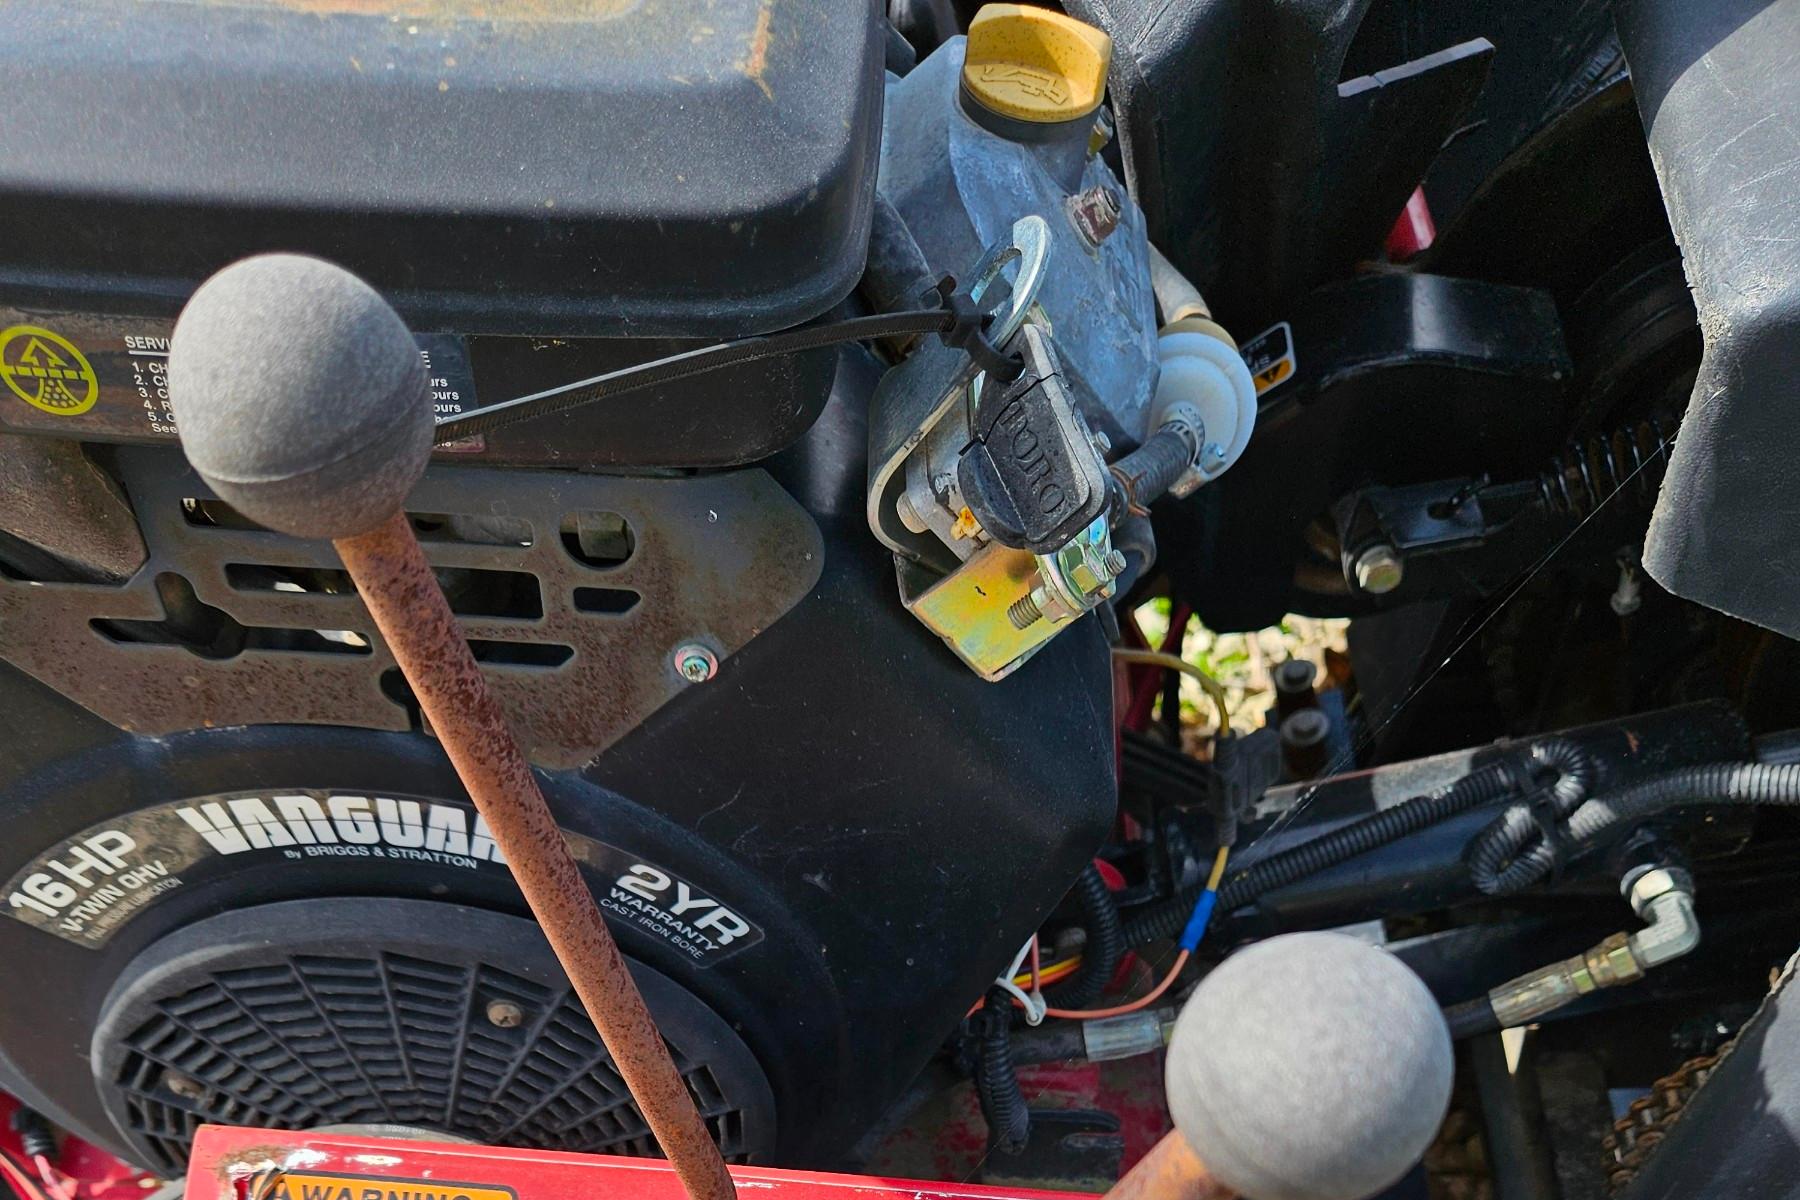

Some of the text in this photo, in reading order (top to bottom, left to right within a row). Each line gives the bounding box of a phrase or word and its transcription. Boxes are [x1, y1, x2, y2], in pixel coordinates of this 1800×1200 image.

[152, 423, 177, 433] See
[175, 795, 508, 866] VANGUAR
[285, 845, 477, 869] By BRIGGS & STRATTON
[60, 860, 168, 932] V-TWIN OHV
[610, 887, 719, 951] WARRANTY
[600, 898, 705, 959] CAST IRON BORE
